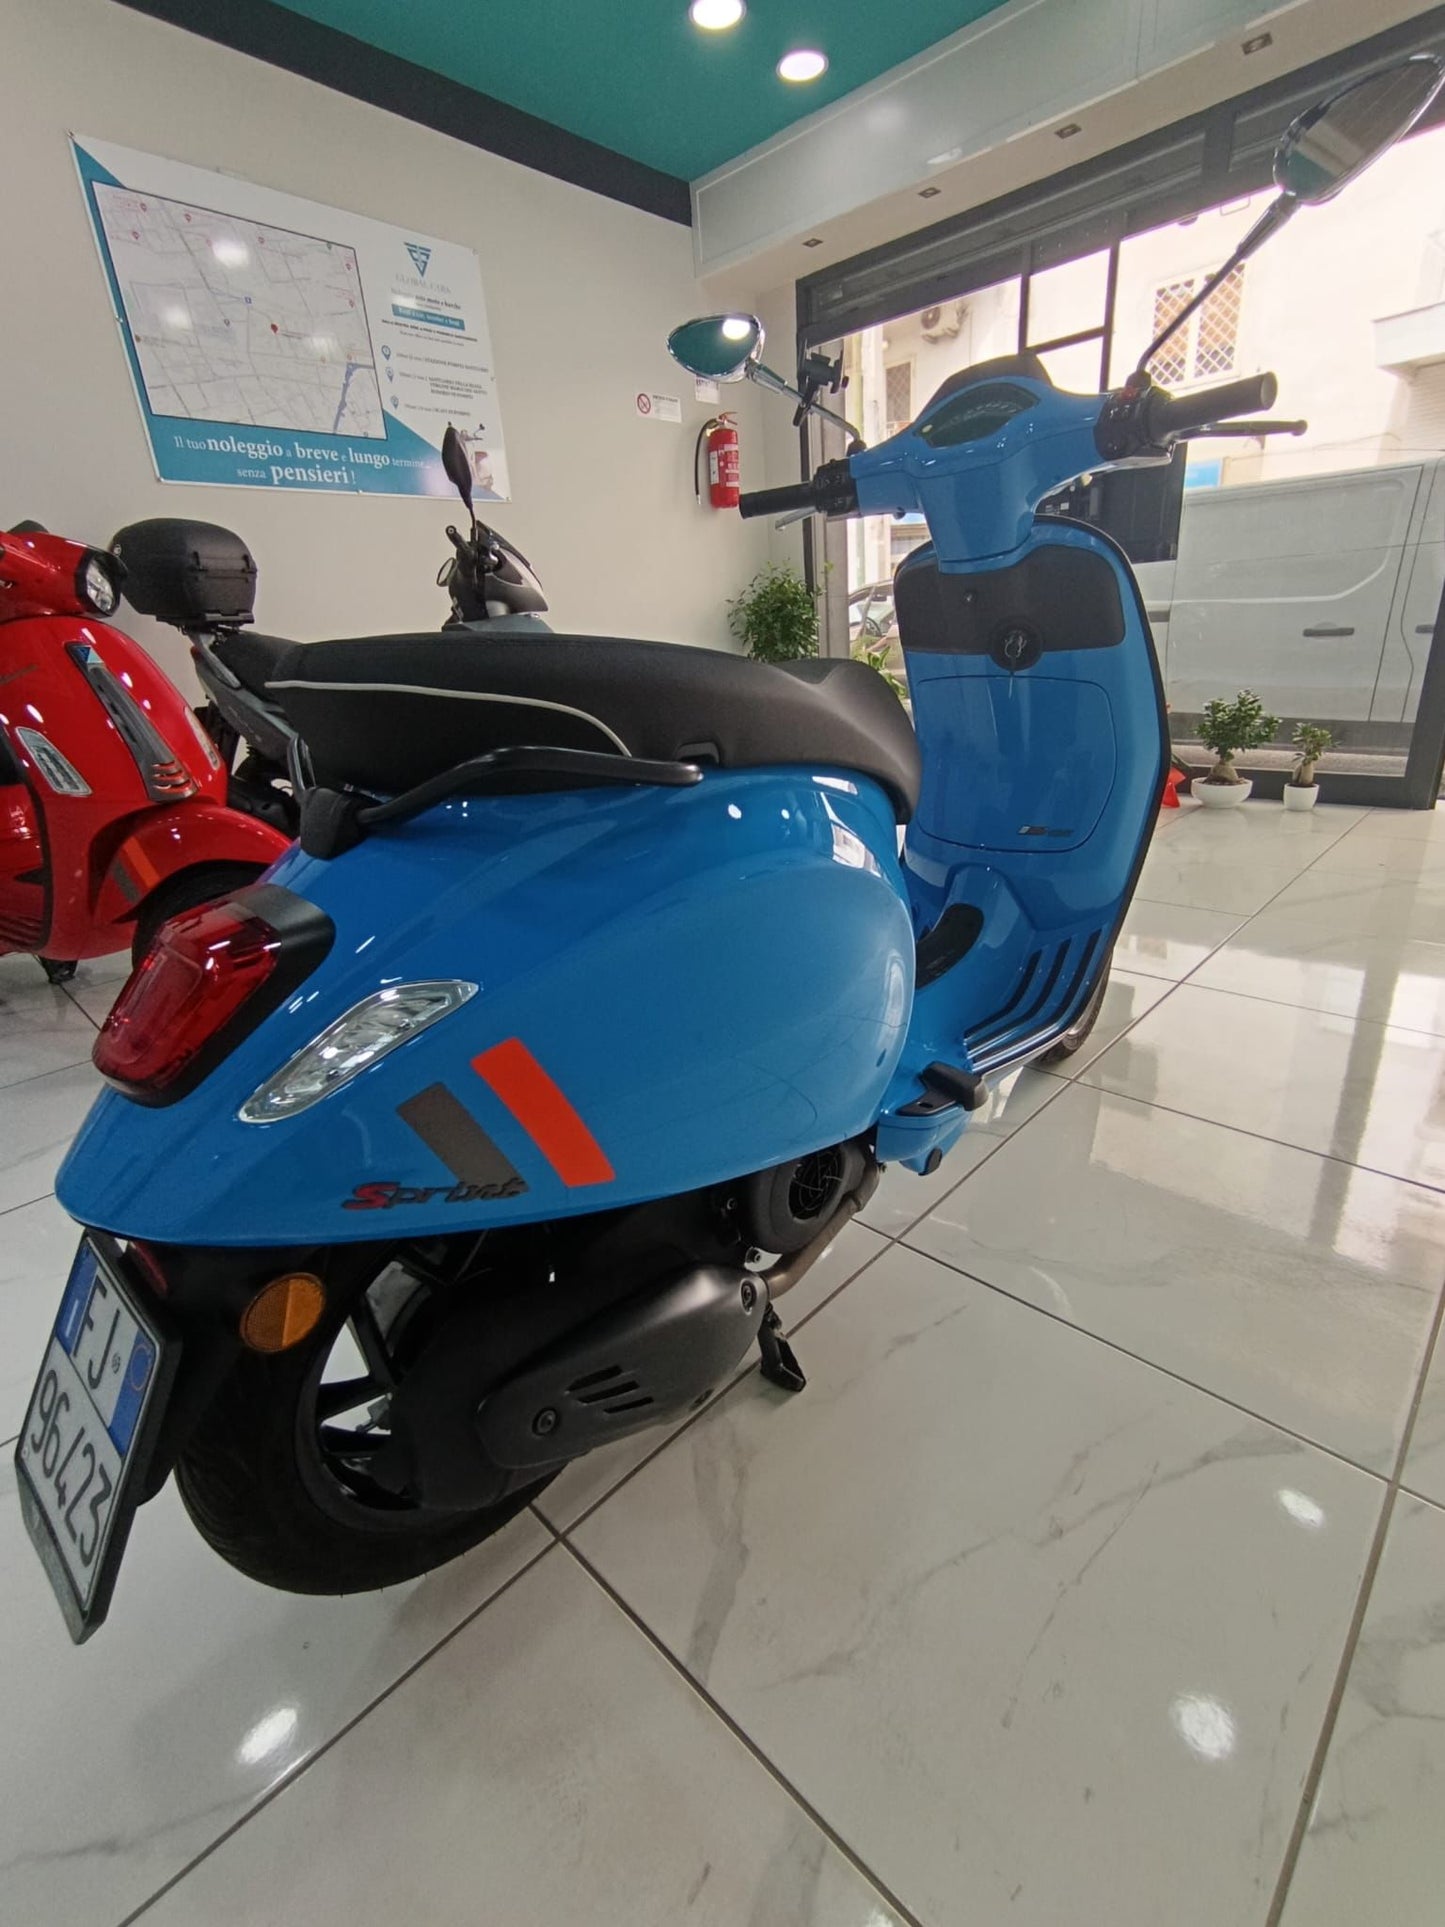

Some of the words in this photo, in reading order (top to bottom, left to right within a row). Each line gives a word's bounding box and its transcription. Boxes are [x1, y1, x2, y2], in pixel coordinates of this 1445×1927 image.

[174, 435, 184, 449] Il
[186, 438, 207, 451] tuo
[205, 435, 284, 461] noleggio
[286, 448, 293, 458] a
[294, 442, 339, 462] breve
[341, 454, 347, 462] e
[348, 447, 390, 469] lungo
[236, 467, 267, 479] senza
[72, 1274, 121, 1390] FJ
[31, 1369, 113, 1569] 96423
